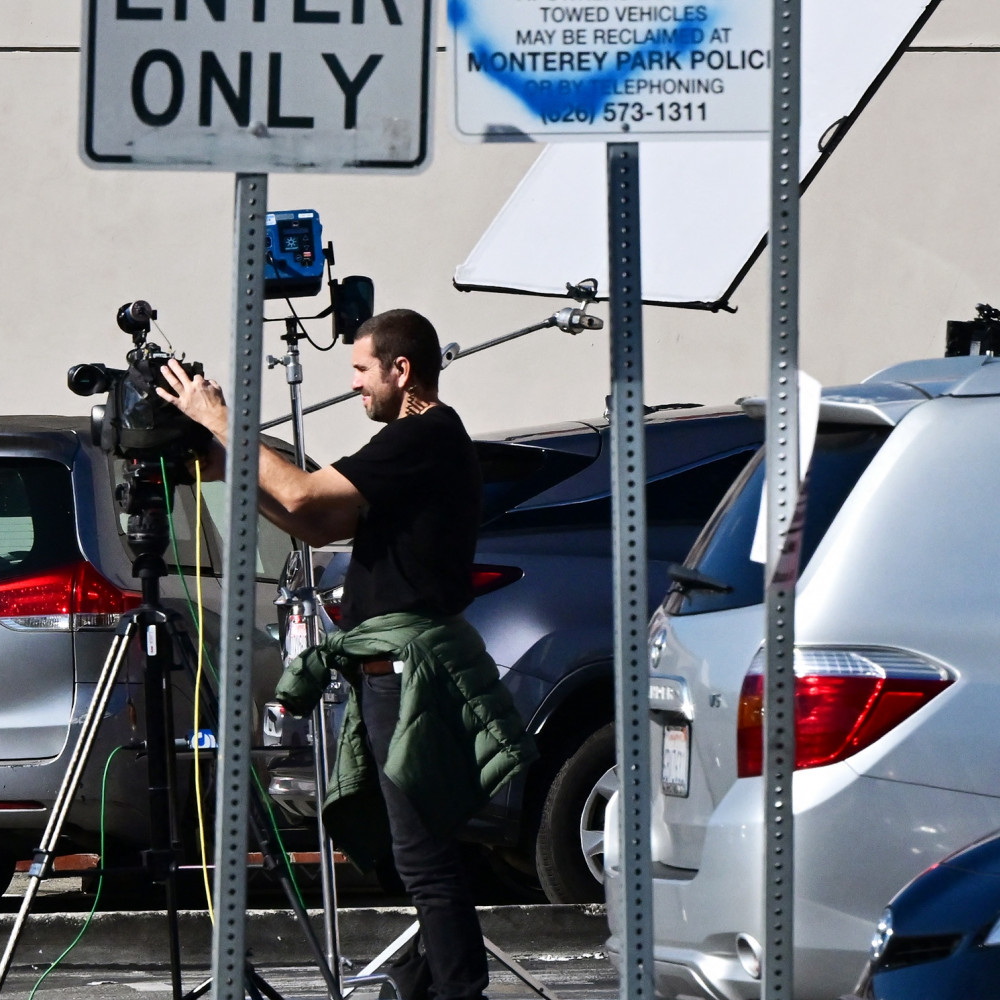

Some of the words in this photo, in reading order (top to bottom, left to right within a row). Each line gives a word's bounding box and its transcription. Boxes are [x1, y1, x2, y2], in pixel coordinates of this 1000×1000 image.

[540, 7, 609, 23] TOWED
[616, 6, 708, 22] VEHICLES
[516, 29, 556, 46] MAY
[562, 29, 586, 45] BE
[593, 28, 704, 45] RECLAIMED
[709, 28, 732, 44] AT
[468, 52, 608, 73] MONTEREY
[616, 51, 682, 71] PARK
[131, 48, 385, 130] ONLY
[603, 102, 707, 123] 573-1311
